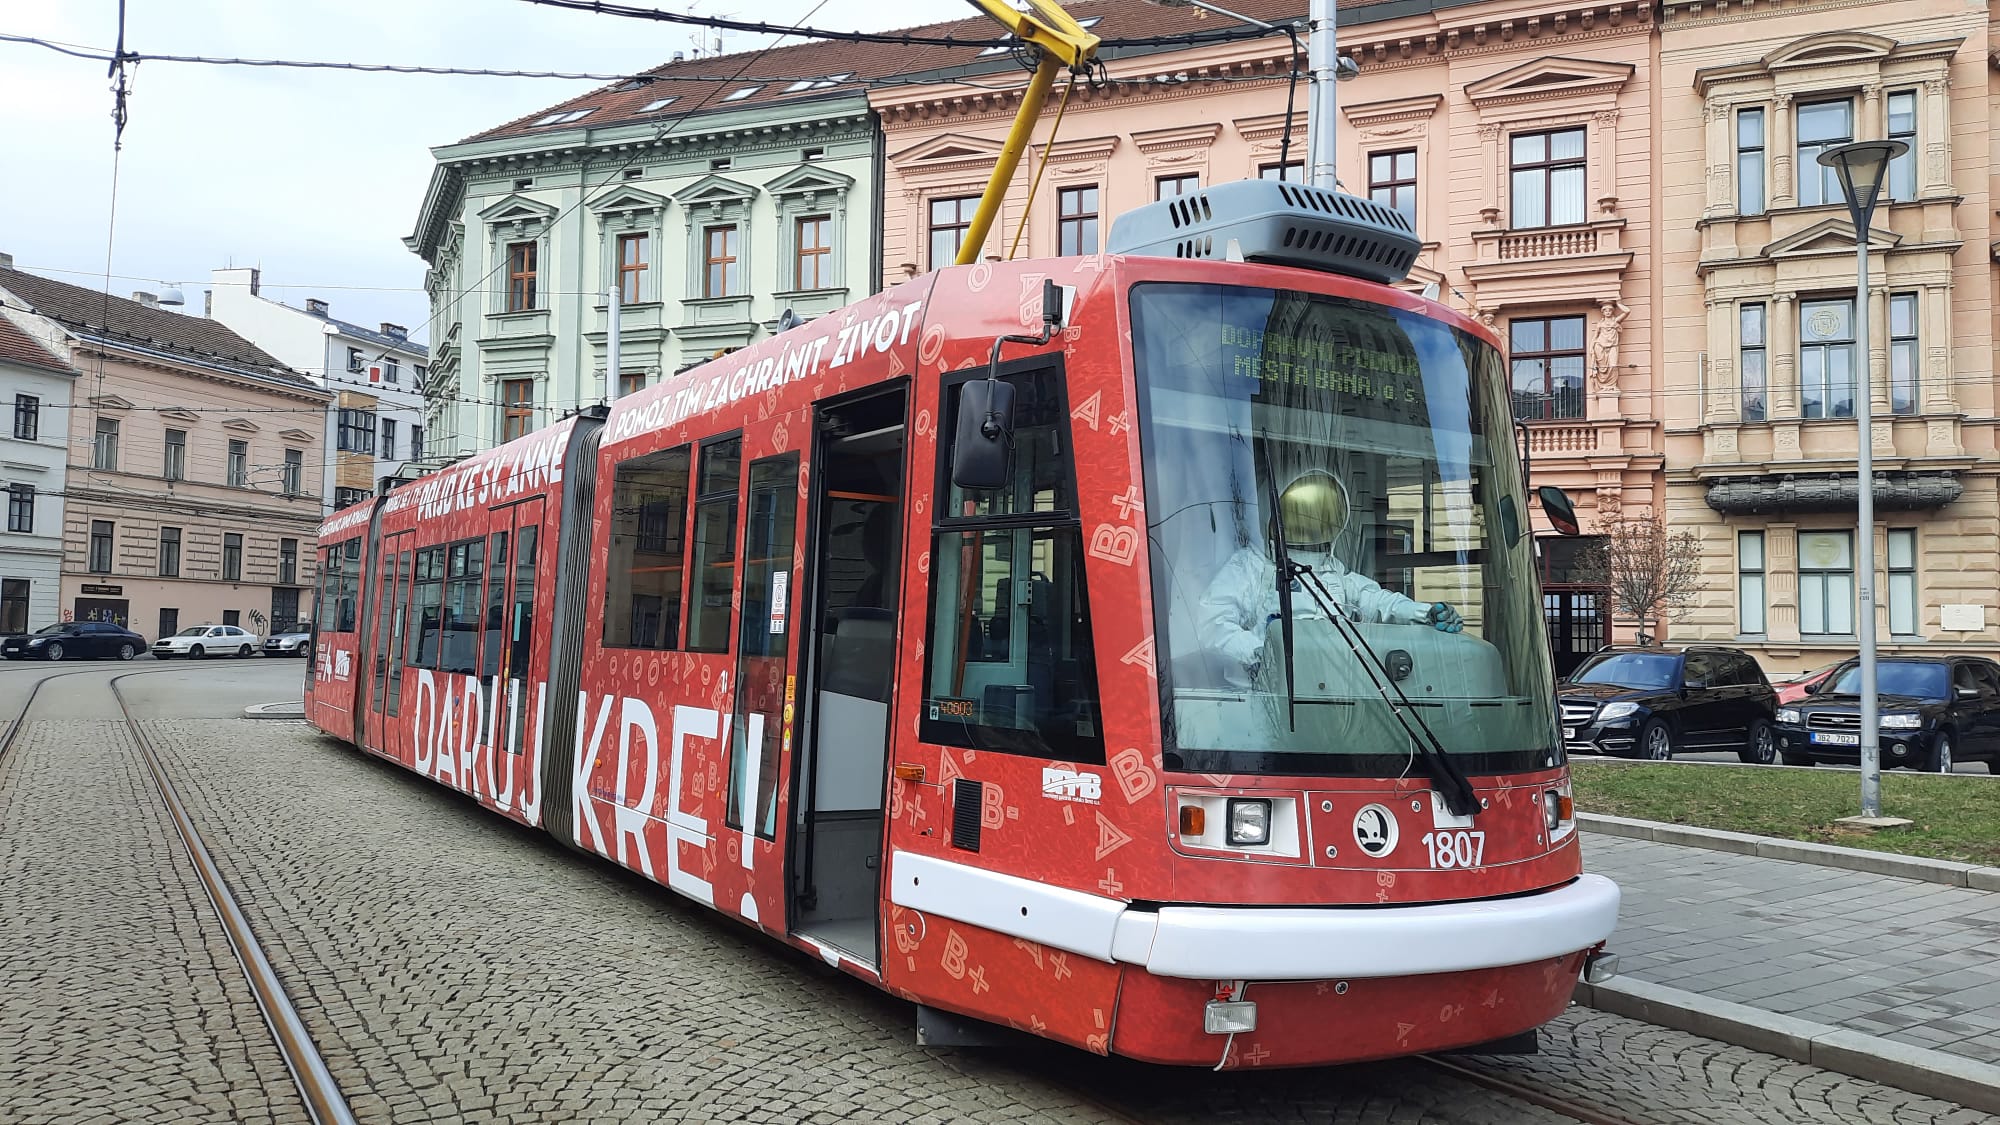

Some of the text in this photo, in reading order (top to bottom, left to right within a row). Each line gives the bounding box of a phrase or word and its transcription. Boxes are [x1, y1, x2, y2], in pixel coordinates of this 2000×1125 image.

[614, 394, 672, 441] POMOZ
[672, 378, 707, 421] TÍM
[703, 335, 830, 411] ZACHRÁNIT
[829, 301, 922, 369] ŽIVOT
[1234, 350, 1308, 386] MĚSTA
[456, 464, 482, 511] KE
[414, 669, 546, 826] DARUJ
[1421, 831, 1485, 869] 1807
